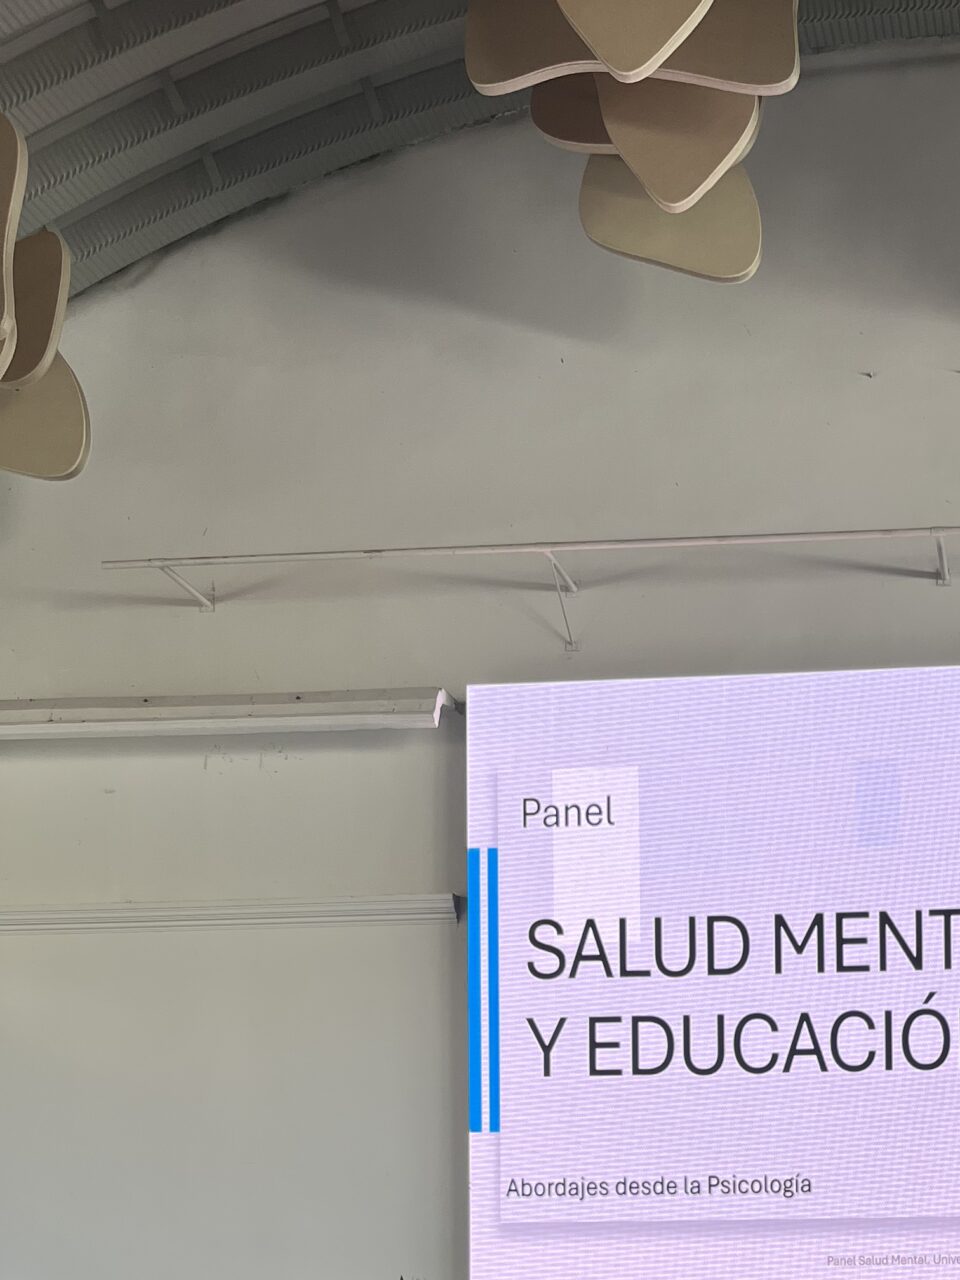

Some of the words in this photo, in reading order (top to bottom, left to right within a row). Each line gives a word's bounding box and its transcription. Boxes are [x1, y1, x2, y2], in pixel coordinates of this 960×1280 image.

[521, 796, 615, 828] Panel
[526, 915, 751, 980] SALUD
[526, 1016, 568, 1078] Y
[506, 1176, 609, 1201] Abordajes
[615, 1176, 679, 1196] desde
[683, 1175, 702, 1195] la
[707, 1173, 813, 1199] Psicología
[827, 1256, 856, 1266] Panel
[858, 1256, 889, 1266] Salud
